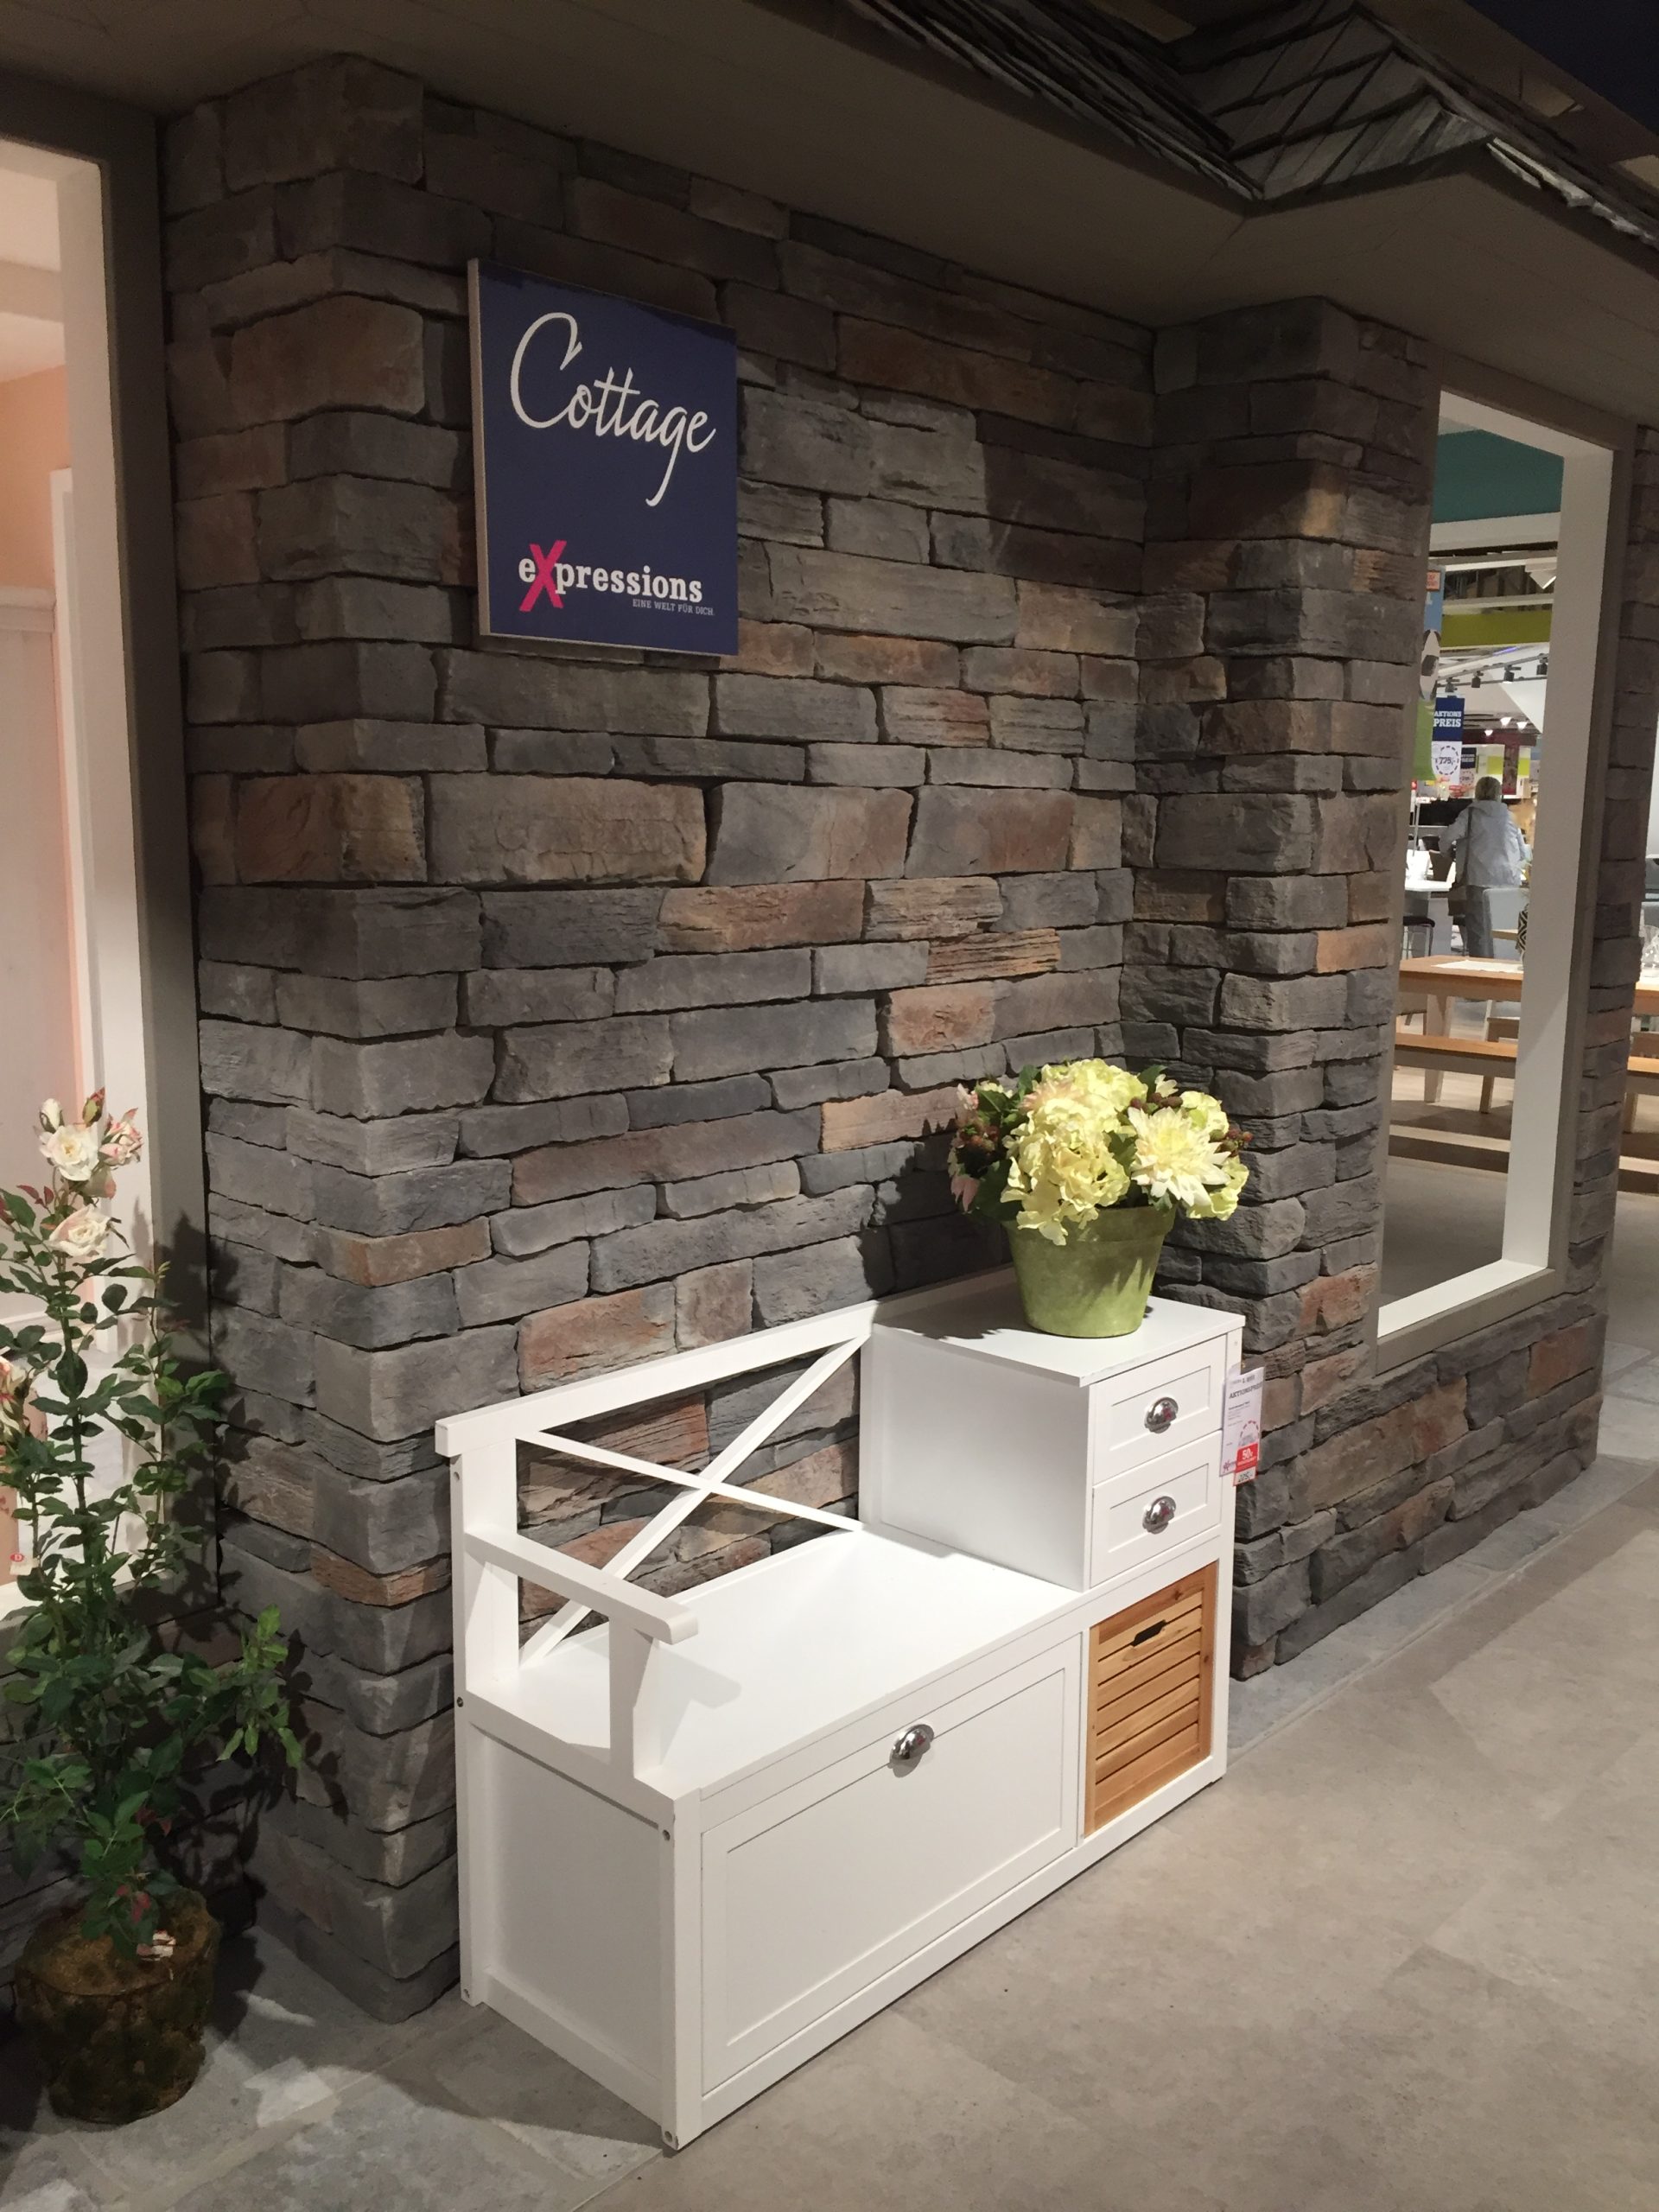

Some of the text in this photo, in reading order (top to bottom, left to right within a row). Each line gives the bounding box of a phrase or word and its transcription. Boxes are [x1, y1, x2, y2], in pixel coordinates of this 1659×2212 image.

[511, 312, 716, 507] Cottage
[518, 539, 702, 612] eXpressions
[632, 599, 652, 608] EINE
[654, 601, 675, 612] WELT
[677, 603, 693, 613] FÜR
[1433, 718, 1461, 727] PREIS
